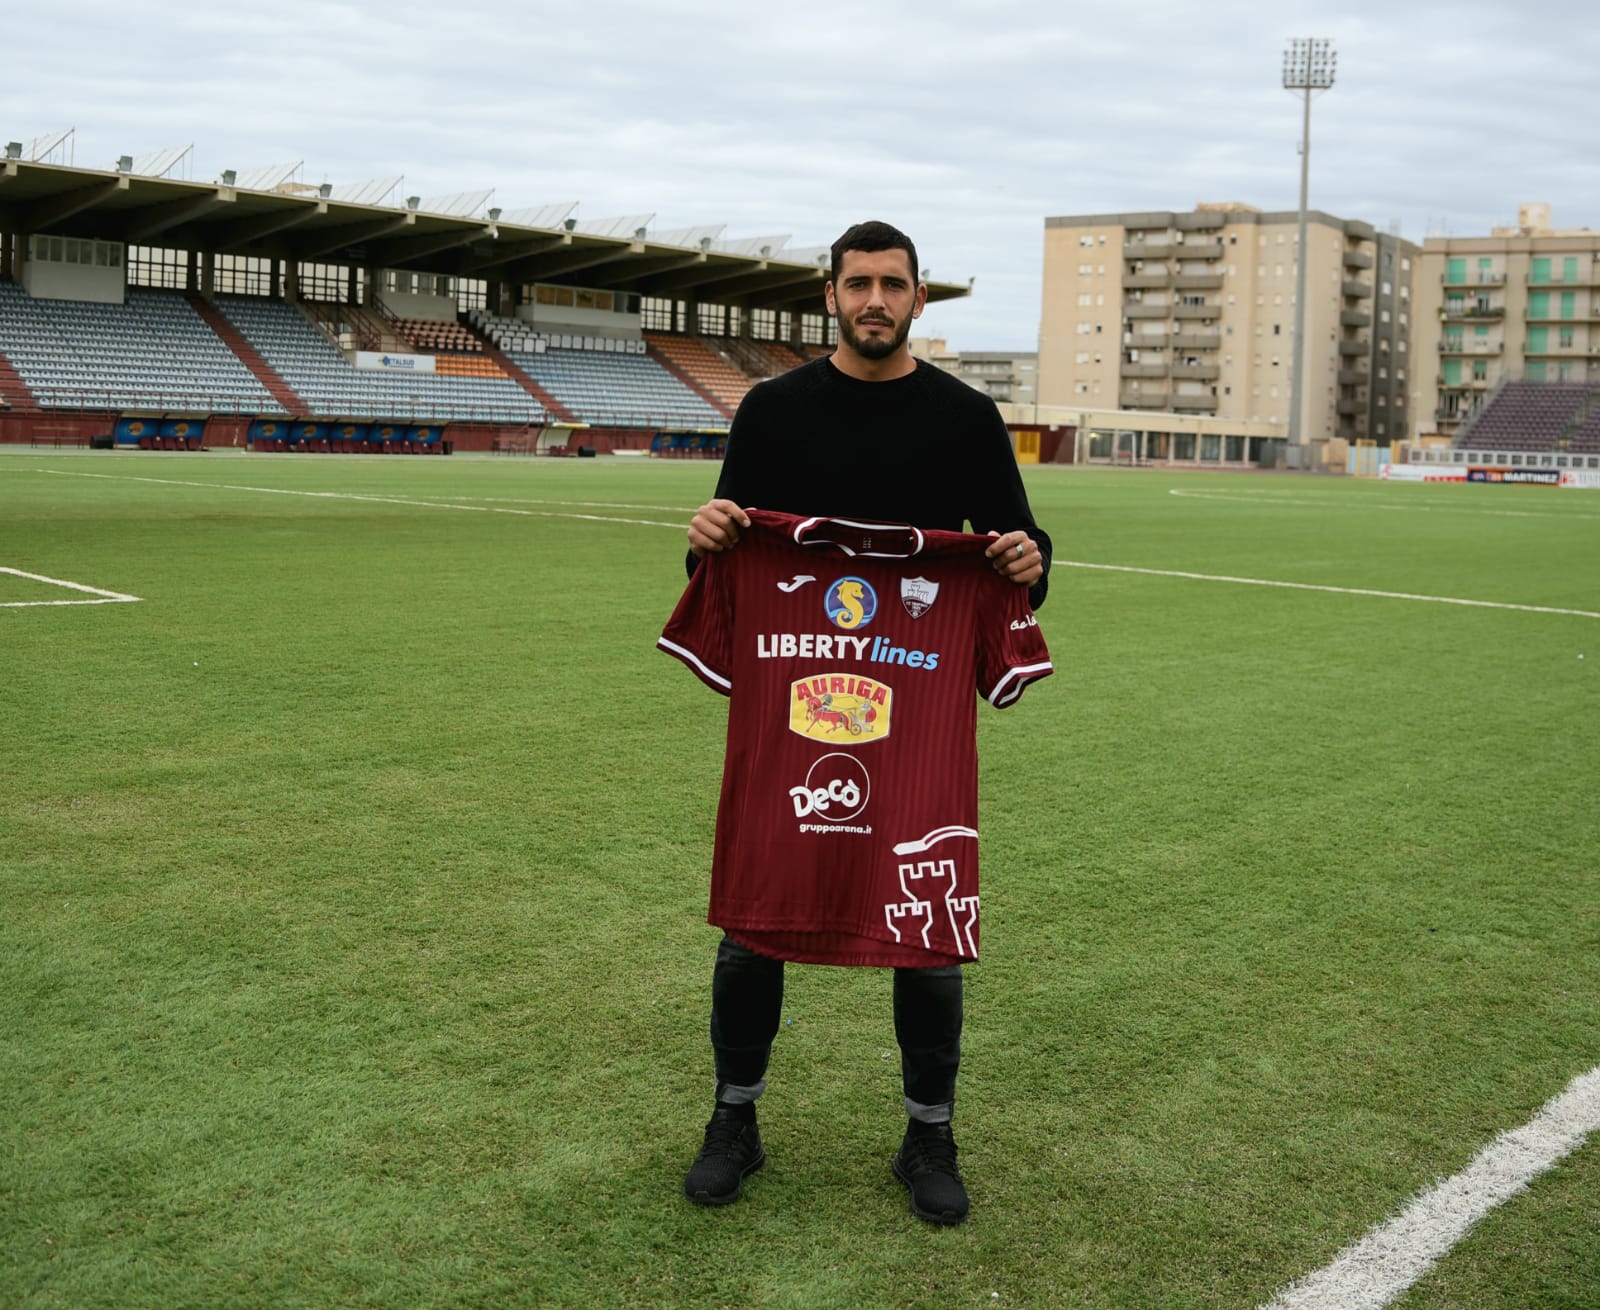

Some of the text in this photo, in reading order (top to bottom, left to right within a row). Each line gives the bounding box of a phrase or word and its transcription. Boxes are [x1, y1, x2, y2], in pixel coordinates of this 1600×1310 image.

[757, 634, 940, 671] LIBERTY lines
[796, 677, 887, 706] AURIGA
[799, 823, 873, 835] gruppoarena.it
